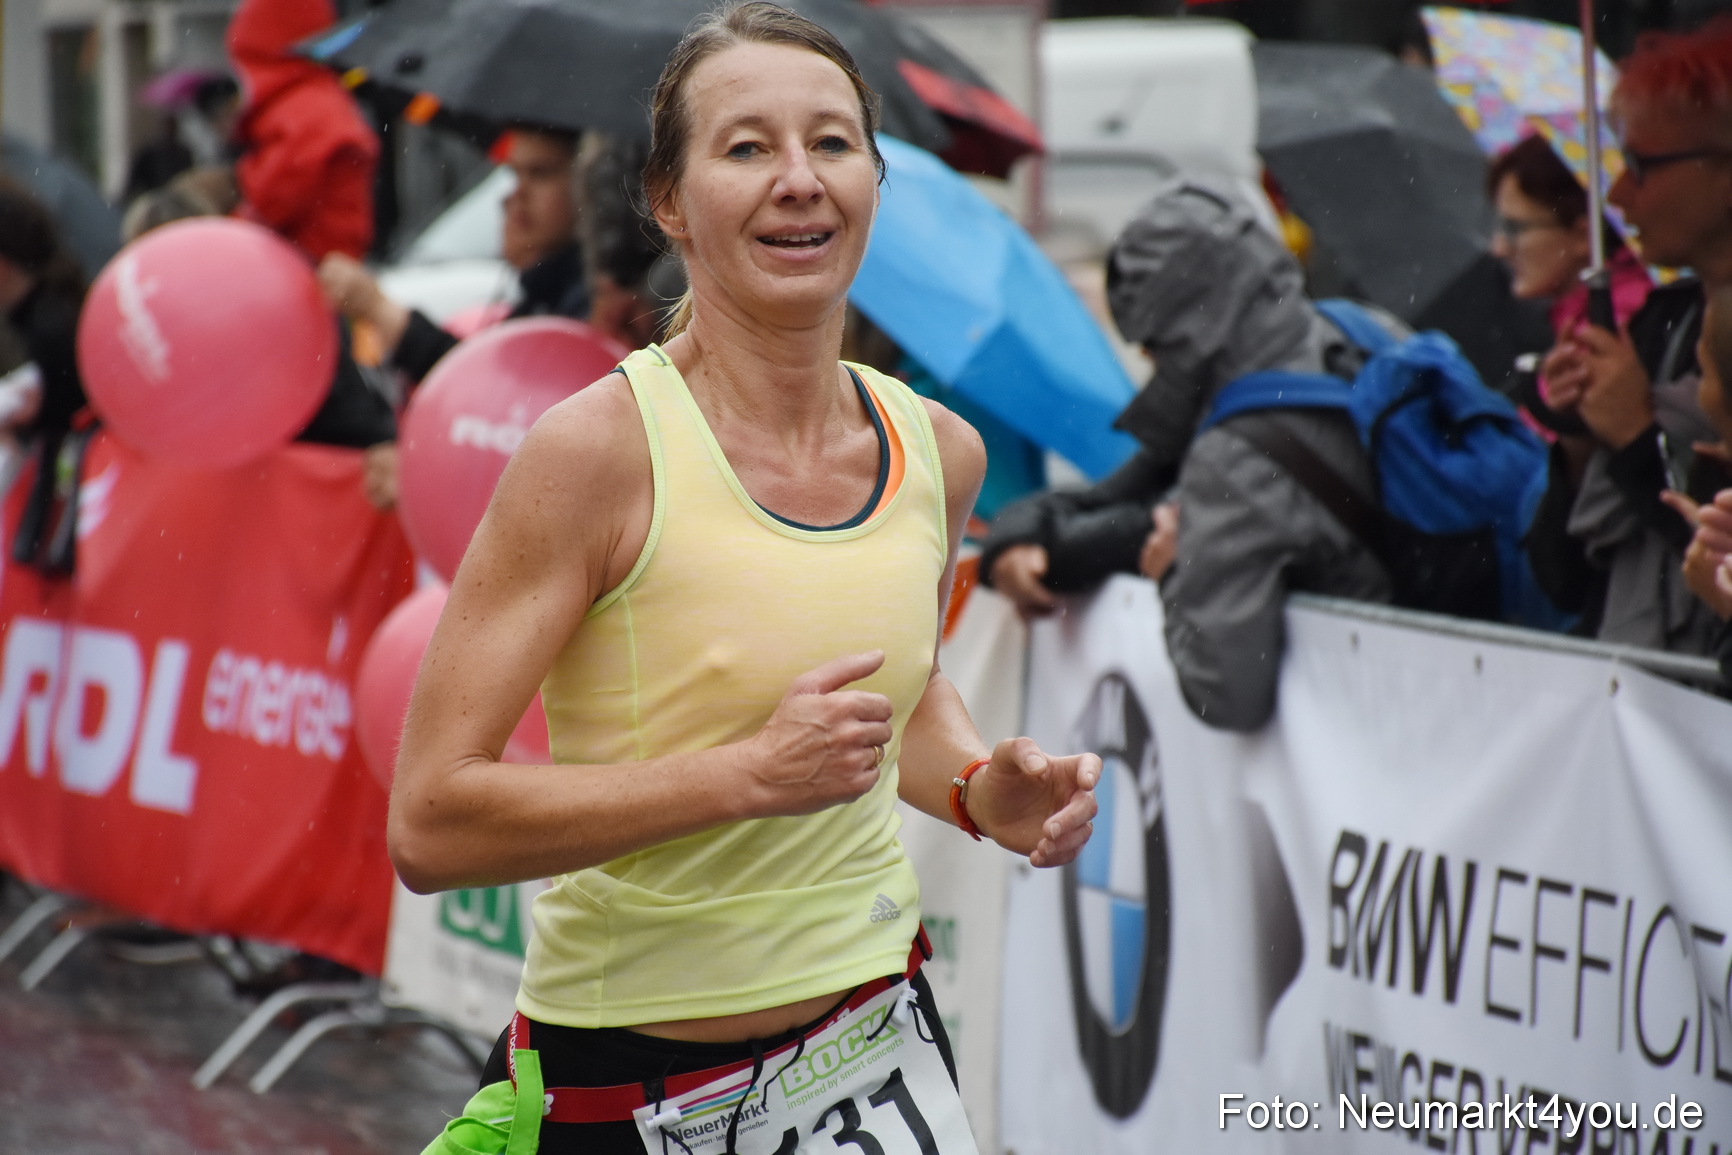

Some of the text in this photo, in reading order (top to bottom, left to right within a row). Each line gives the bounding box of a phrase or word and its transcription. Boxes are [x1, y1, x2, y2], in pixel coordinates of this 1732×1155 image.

[870, 909, 901, 923] adidas
[1327, 829, 1732, 1085] BMW EFFICIE
[776, 1004, 899, 1098] BOCK
[786, 1037, 905, 1110] inspired by smart concepts
[680, 1137, 713, 1153] ekaufen
[772, 1067, 941, 1155] 31
